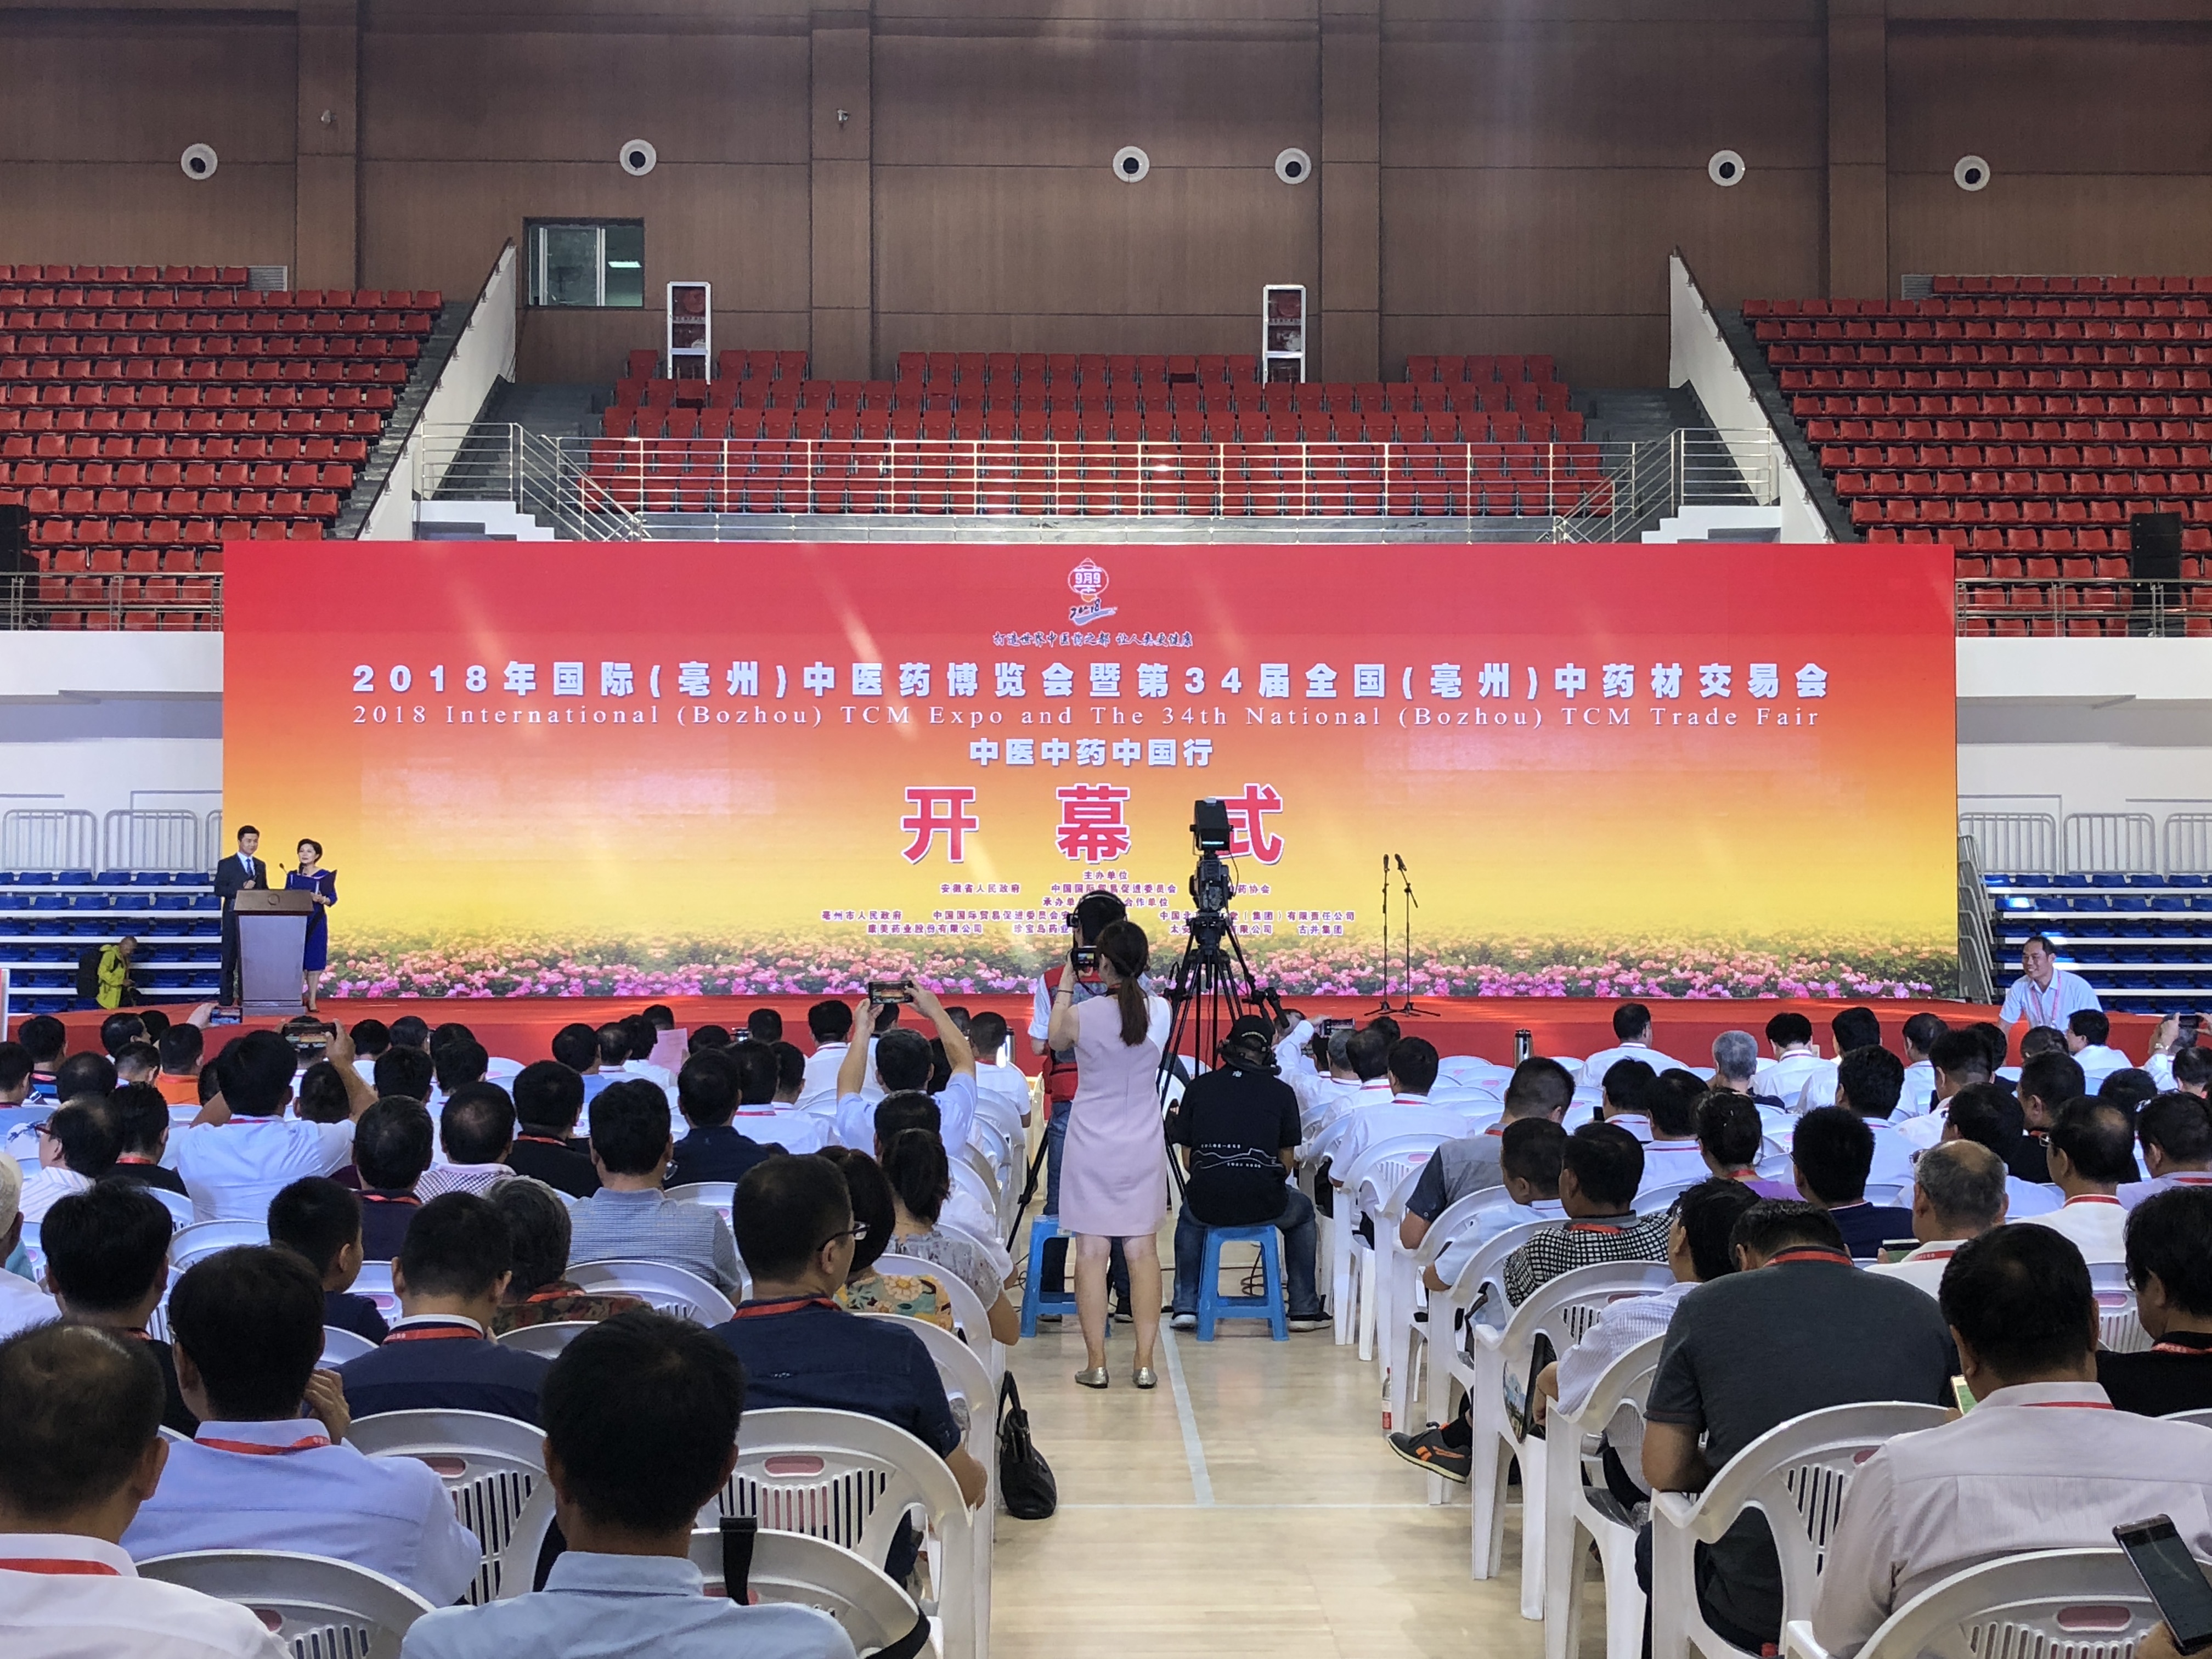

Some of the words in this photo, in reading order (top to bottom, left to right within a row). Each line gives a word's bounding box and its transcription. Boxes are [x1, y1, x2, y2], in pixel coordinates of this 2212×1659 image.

[992, 630, 1111, 648] 打造世界中医药之都
[1115, 630, 1194, 648] 让人类更健康
[353, 705, 426, 724] 2018
[446, 705, 658, 724] International
[677, 705, 822, 727] (Bozhou)
[840, 706, 911, 725] TCM
[929, 706, 1003, 729] Expo
[1022, 706, 1072, 725] and
[1090, 706, 1143, 725] The
[1163, 706, 1227, 725] 34th
[1245, 707, 1380, 725] National
[1398, 707, 1543, 729] (Bozhou)
[1560, 707, 1630, 725] TCM
[1650, 707, 1737, 726] Trade
[1757, 707, 1819, 726] Fair
[969, 737, 1213, 767] 中医中药中国行
[1082, 870, 1128, 881] 主办单位
[940, 883, 1021, 894] 安徽省人民政府
[1050, 883, 1177, 895] 中国国际贸易促进委员会
[1042, 896, 1076, 907] 承办单
[821, 909, 902, 921] 亳州市人民政府
[932, 909, 1070, 921] 中国国际贸易促进委员会安
[867, 923, 984, 934] 康美药业股份有限公司
[1012, 923, 1074, 934] 珍宝岛药业
[1296, 924, 1344, 935] 古井集团
